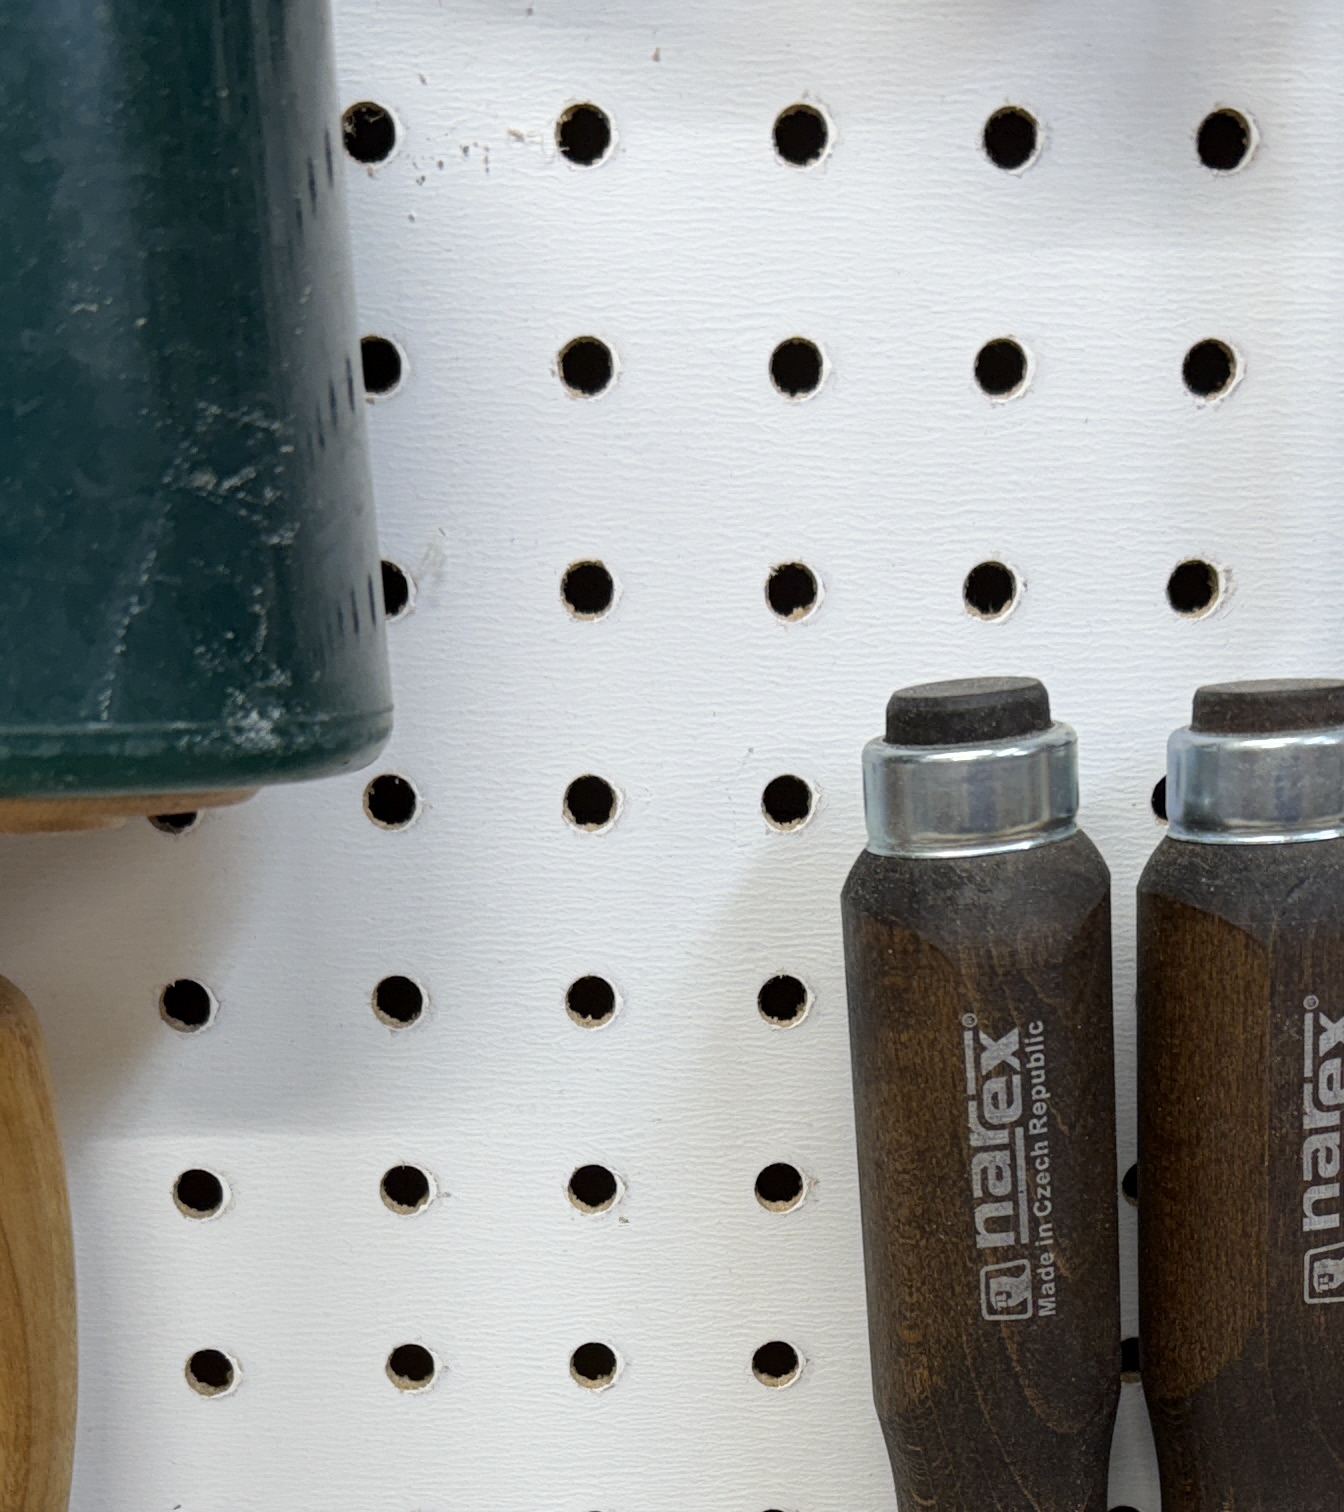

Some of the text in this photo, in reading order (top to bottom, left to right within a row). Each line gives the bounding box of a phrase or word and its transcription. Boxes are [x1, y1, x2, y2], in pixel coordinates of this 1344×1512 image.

[1025, 1020, 1056, 1317] Made in Czech Republic
